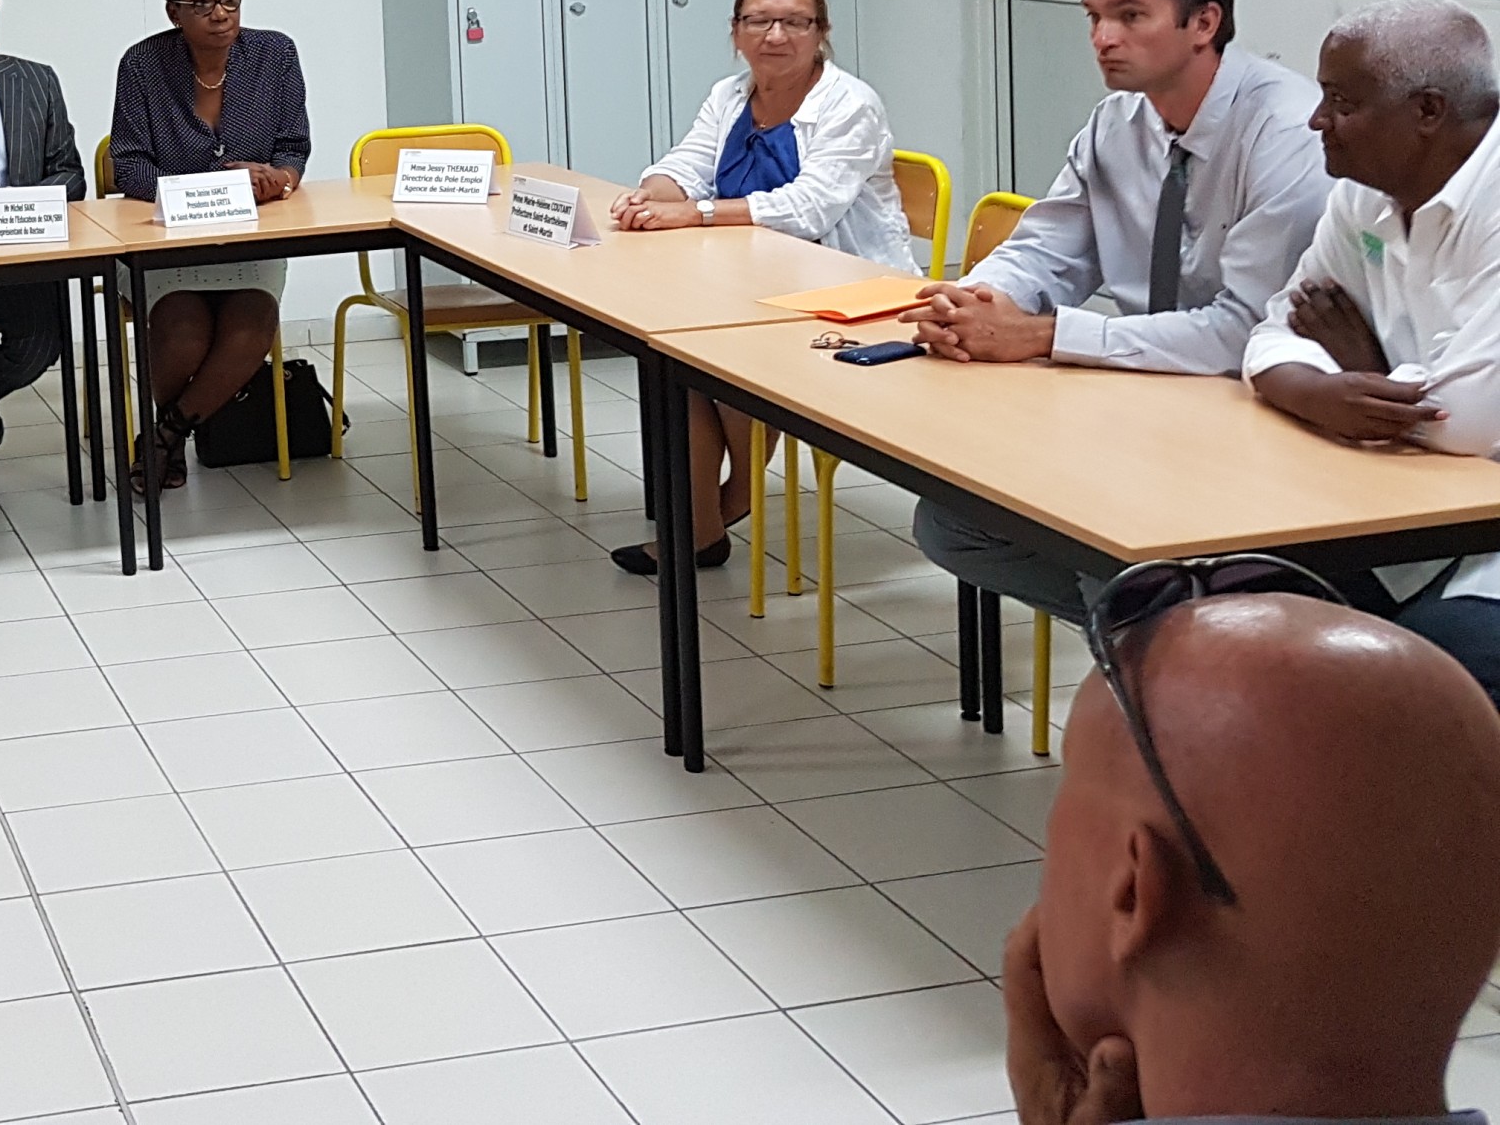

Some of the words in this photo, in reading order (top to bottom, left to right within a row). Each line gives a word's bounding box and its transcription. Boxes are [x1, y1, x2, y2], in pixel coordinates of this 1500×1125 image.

[411, 163, 426, 172] Mme
[427, 164, 445, 174] Jessy
[401, 174, 433, 182] Directrice
[434, 175, 443, 183] du
[460, 176, 483, 184] Emploi
[404, 185, 428, 193] Agence
[429, 185, 438, 193] de
[438, 185, 480, 194] Saint-Martin
